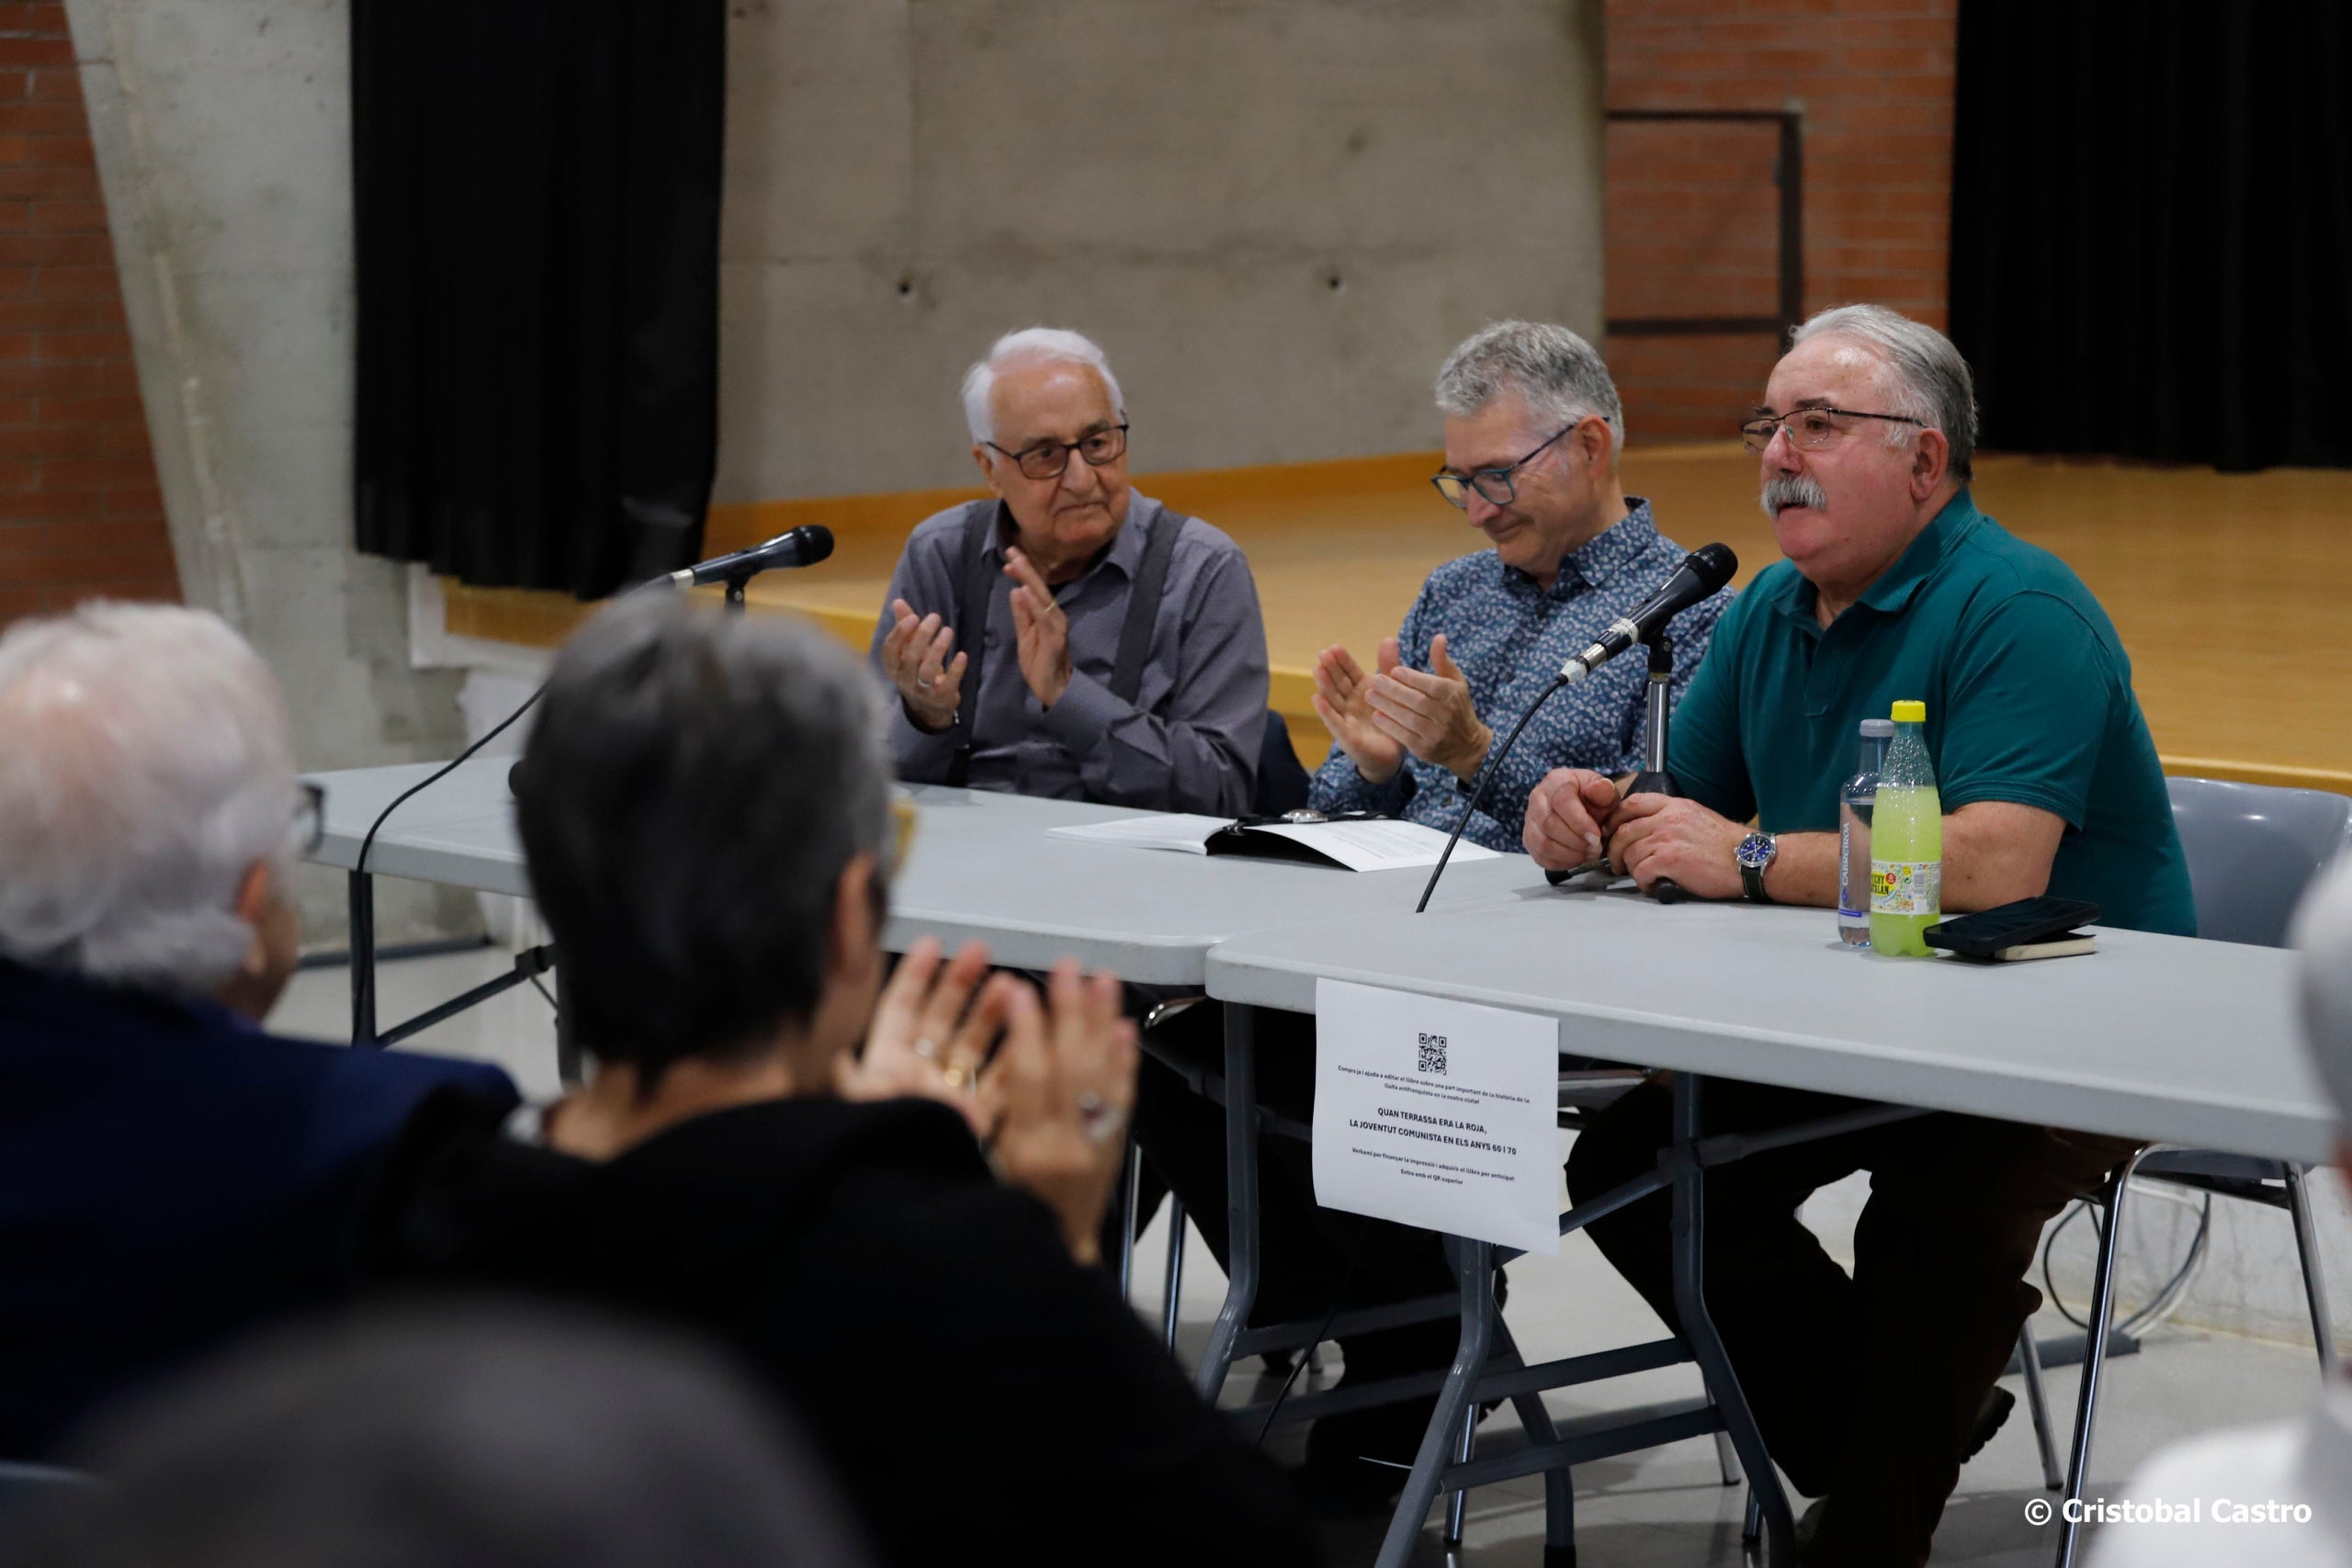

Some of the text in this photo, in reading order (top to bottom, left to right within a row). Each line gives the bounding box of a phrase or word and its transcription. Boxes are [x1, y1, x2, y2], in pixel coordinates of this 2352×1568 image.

[1338, 1066, 1356, 1074] Compra
[1456, 1087, 1481, 1095] important
[1398, 1086, 1433, 1097] antifranquista
[1378, 1107, 1487, 1134] QUAN TERRASSA ERA LA ROJA,
[1350, 1119, 1517, 1156] LA JOVENTUT COMUNISTA EN ELS ANYS 60 I 70
[1352, 1147, 1373, 1156] Verkami
[1439, 1164, 1459, 1172] adquirir
